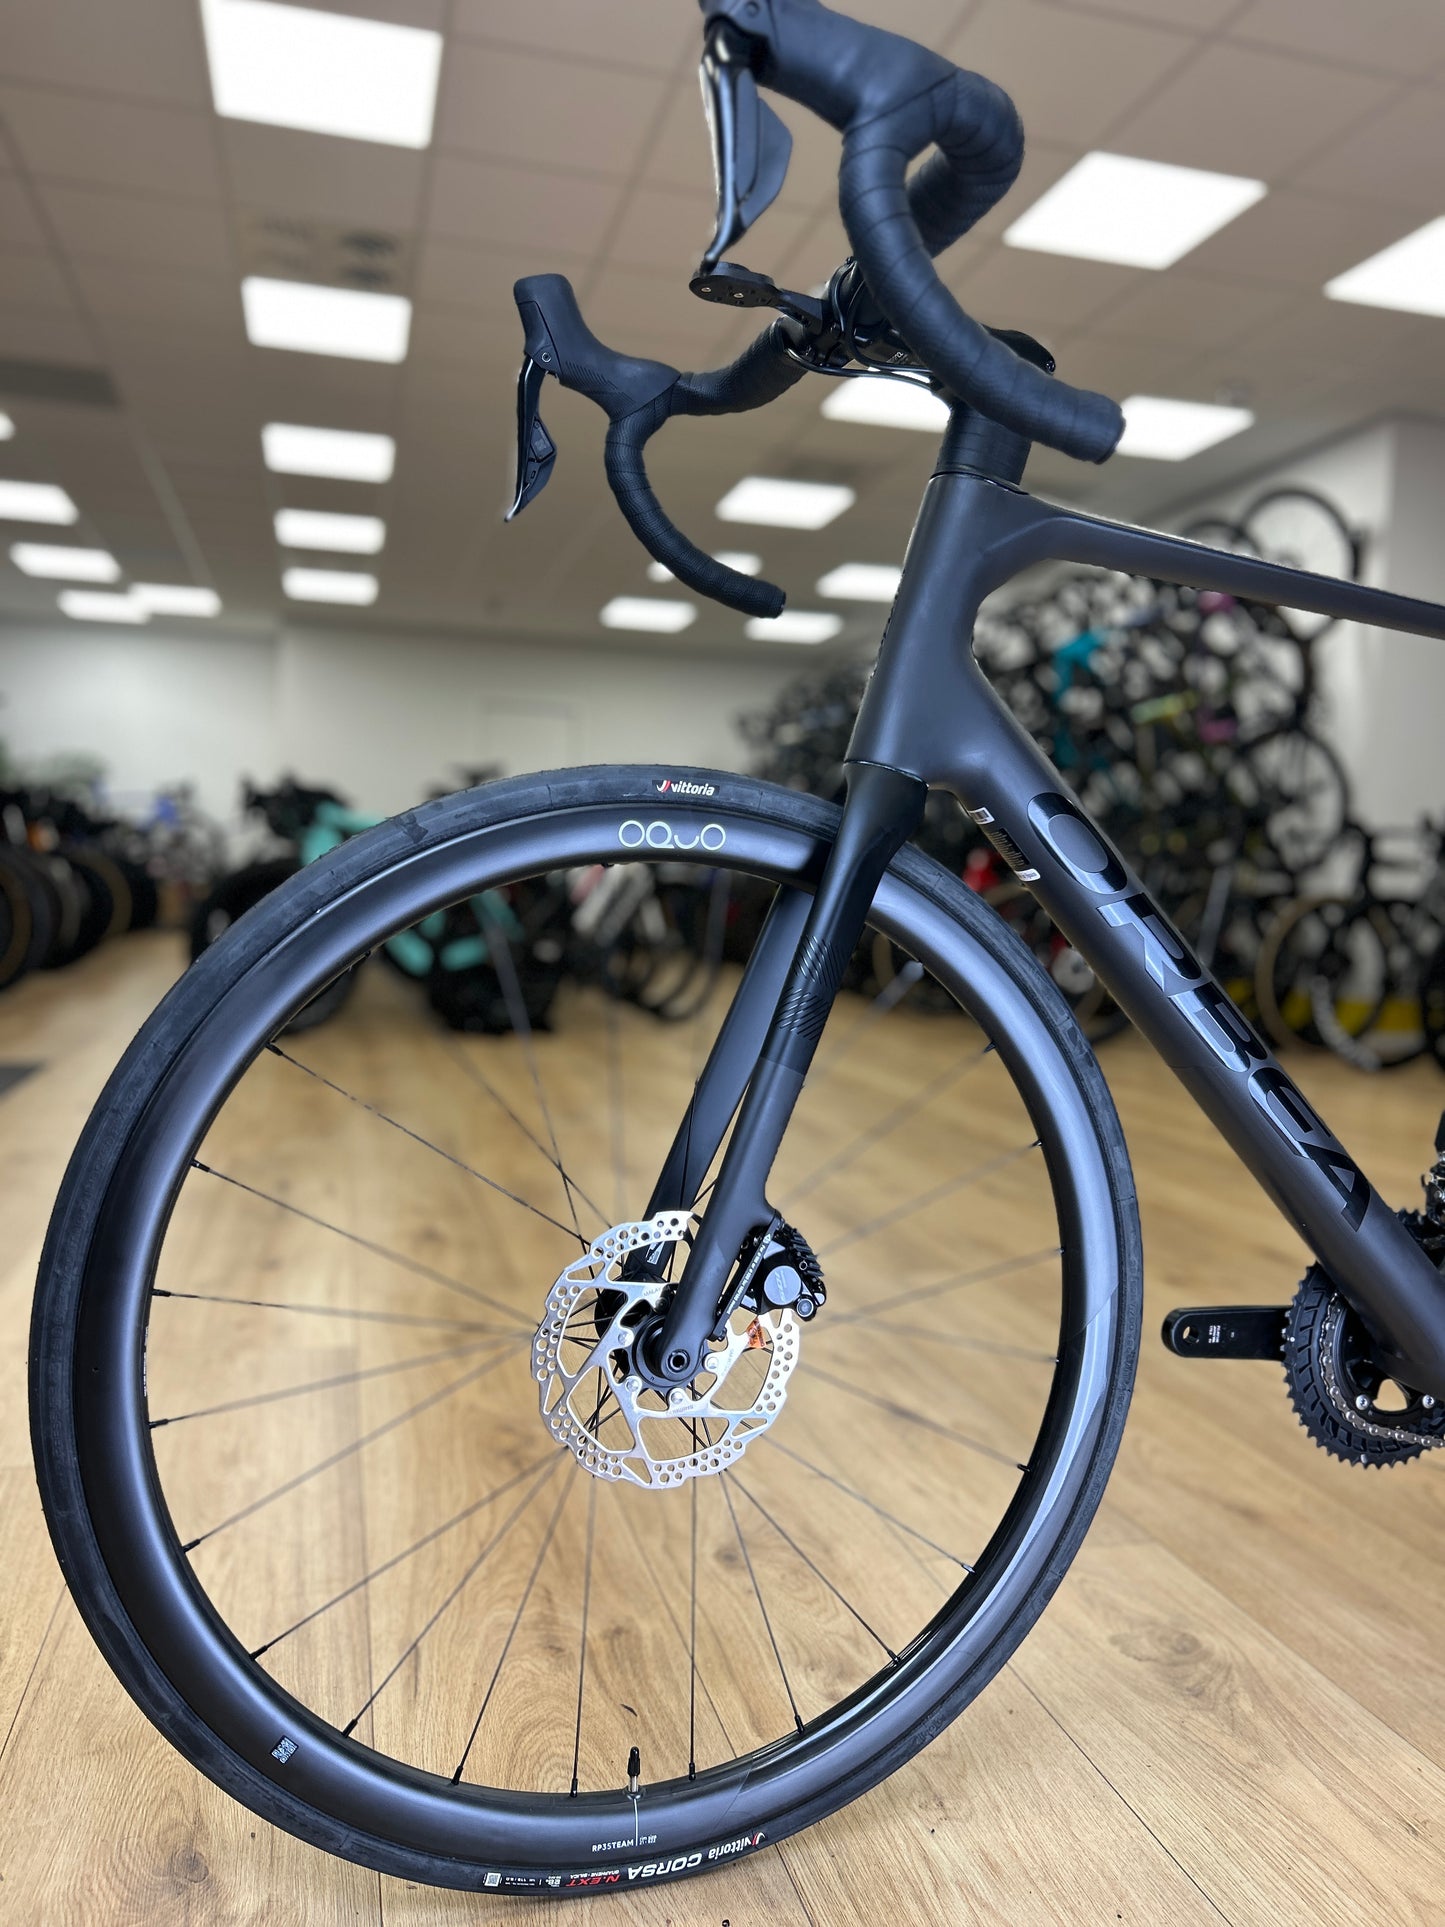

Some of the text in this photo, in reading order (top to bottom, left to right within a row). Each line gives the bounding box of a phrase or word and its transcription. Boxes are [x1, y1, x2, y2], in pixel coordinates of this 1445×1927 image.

[671, 780, 715, 796] vittoria
[618, 820, 726, 851] OQUO
[1027, 792, 1371, 1233] ORBEA
[591, 1838, 634, 1853] RP35TEAM
[628, 1837, 751, 1880] vittoria CORSA
[566, 1874, 620, 1887] N.EXT
